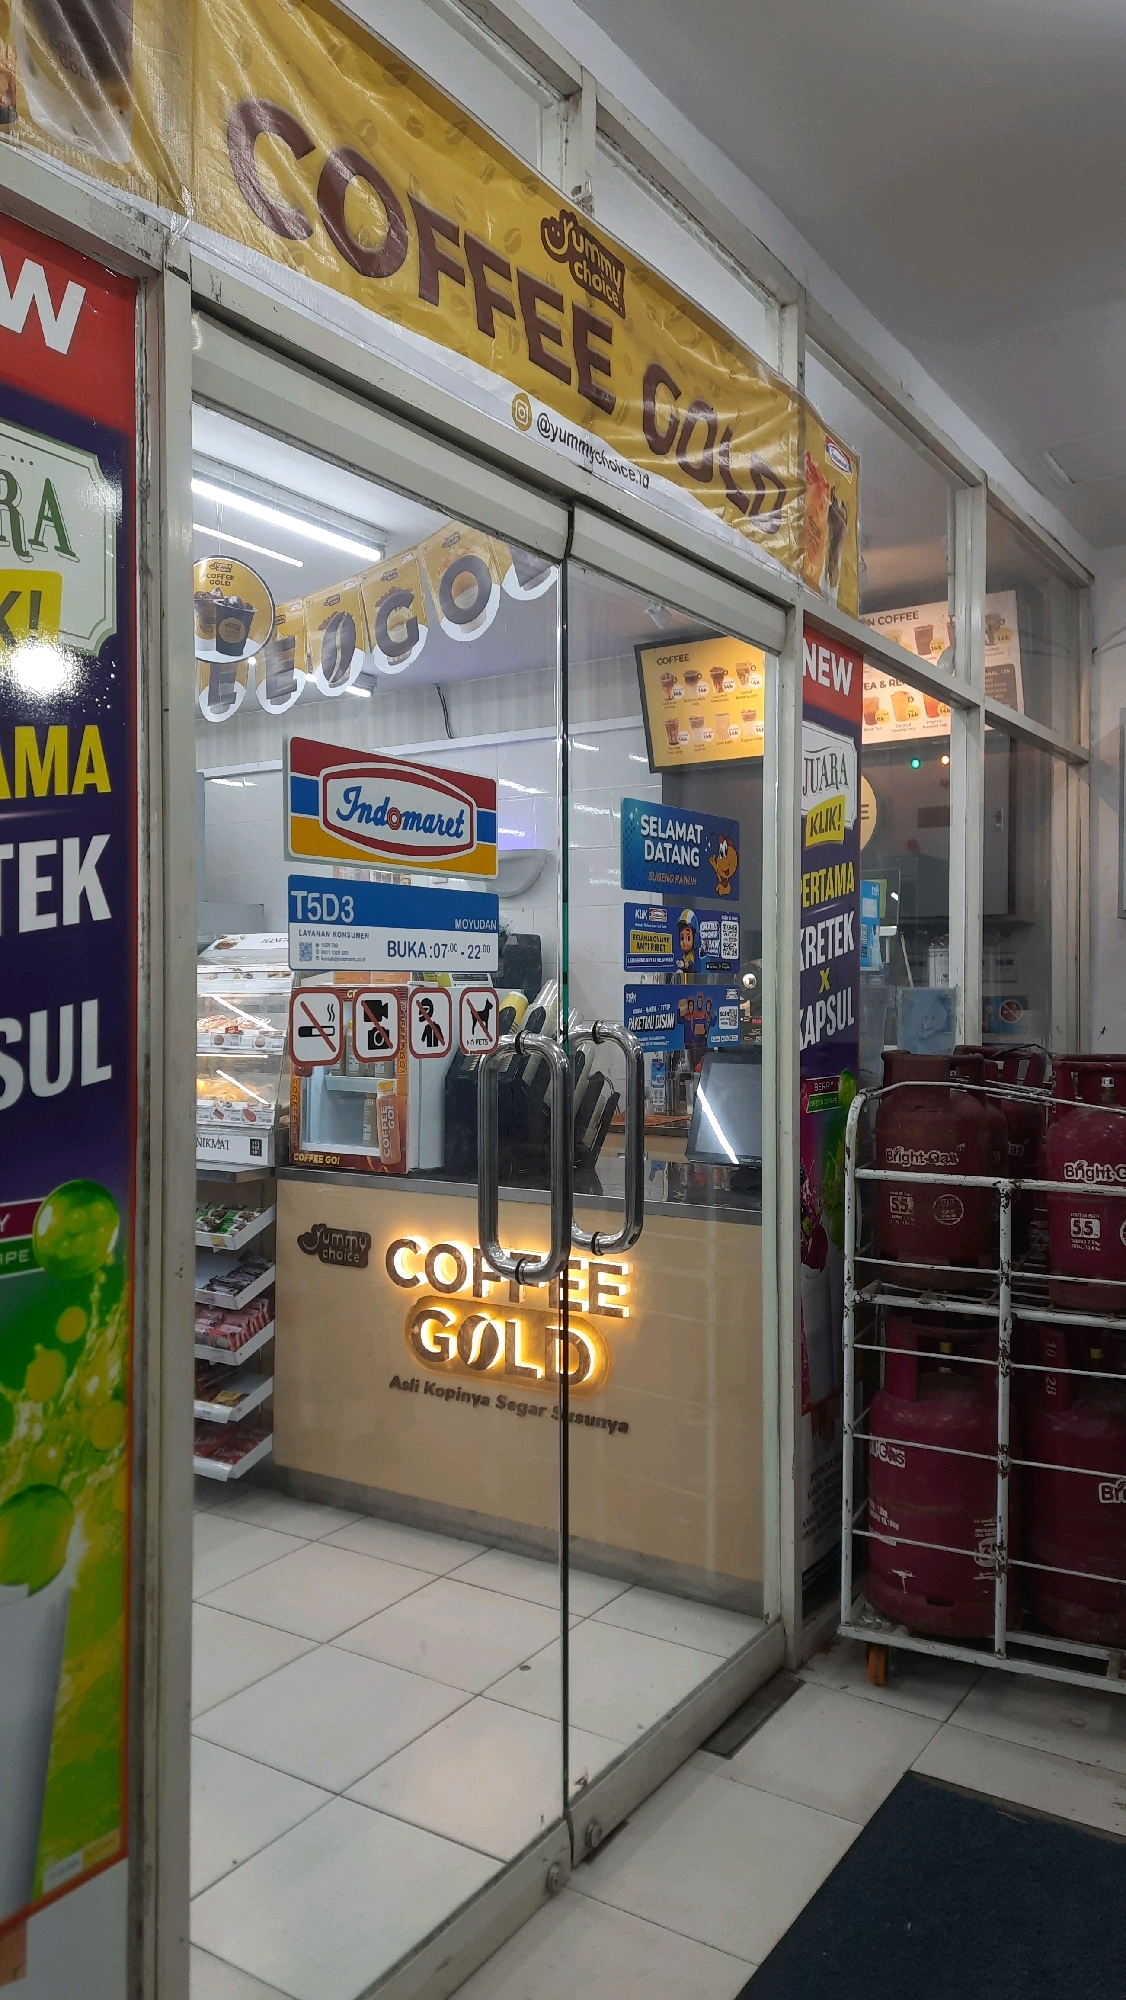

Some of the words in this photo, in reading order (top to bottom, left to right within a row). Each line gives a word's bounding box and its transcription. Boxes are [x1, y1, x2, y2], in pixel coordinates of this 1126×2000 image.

[543, 216, 623, 288] Yummy
[227, 98, 617, 416] COFFEE
[642, 361, 788, 534] GOLD
[877, 610, 920, 626] COFFEE
[656, 653, 690, 666] COFFEE
[802, 638, 854, 697] NEW
[0, 725, 111, 799] MA
[801, 751, 850, 798] JUARA
[336, 786, 465, 838] Indomaret
[808, 806, 843, 838] KLIK!
[640, 813, 704, 846] SELAMAT
[644, 839, 700, 868] DATANG
[291, 891, 354, 923] T5D3
[298, 929, 330, 937] LAYANAN
[332, 932, 369, 940] KONSUMEN
[454, 919, 497, 930] MOYUDAN
[387, 940, 427, 958] BUKA
[819, 968, 831, 994] X
[380, 1105, 389, 1158] COFFEE
[293, 1152, 324, 1164] COFFEE
[325, 1155, 341, 1165] GO!
[885, 1145, 925, 1168] Bright
[1064, 1160, 1114, 1183] Bright
[302, 1228, 367, 1252] Yummy
[322, 1247, 360, 1263] choice
[0, 1248, 29, 1266] PE
[386, 1235, 630, 1319] COFFEE
[411, 1307, 597, 1387] GOLD
[389, 1375, 420, 1393] Asli
[423, 1380, 491, 1408] Kopinya
[495, 1394, 548, 1417] Segar
